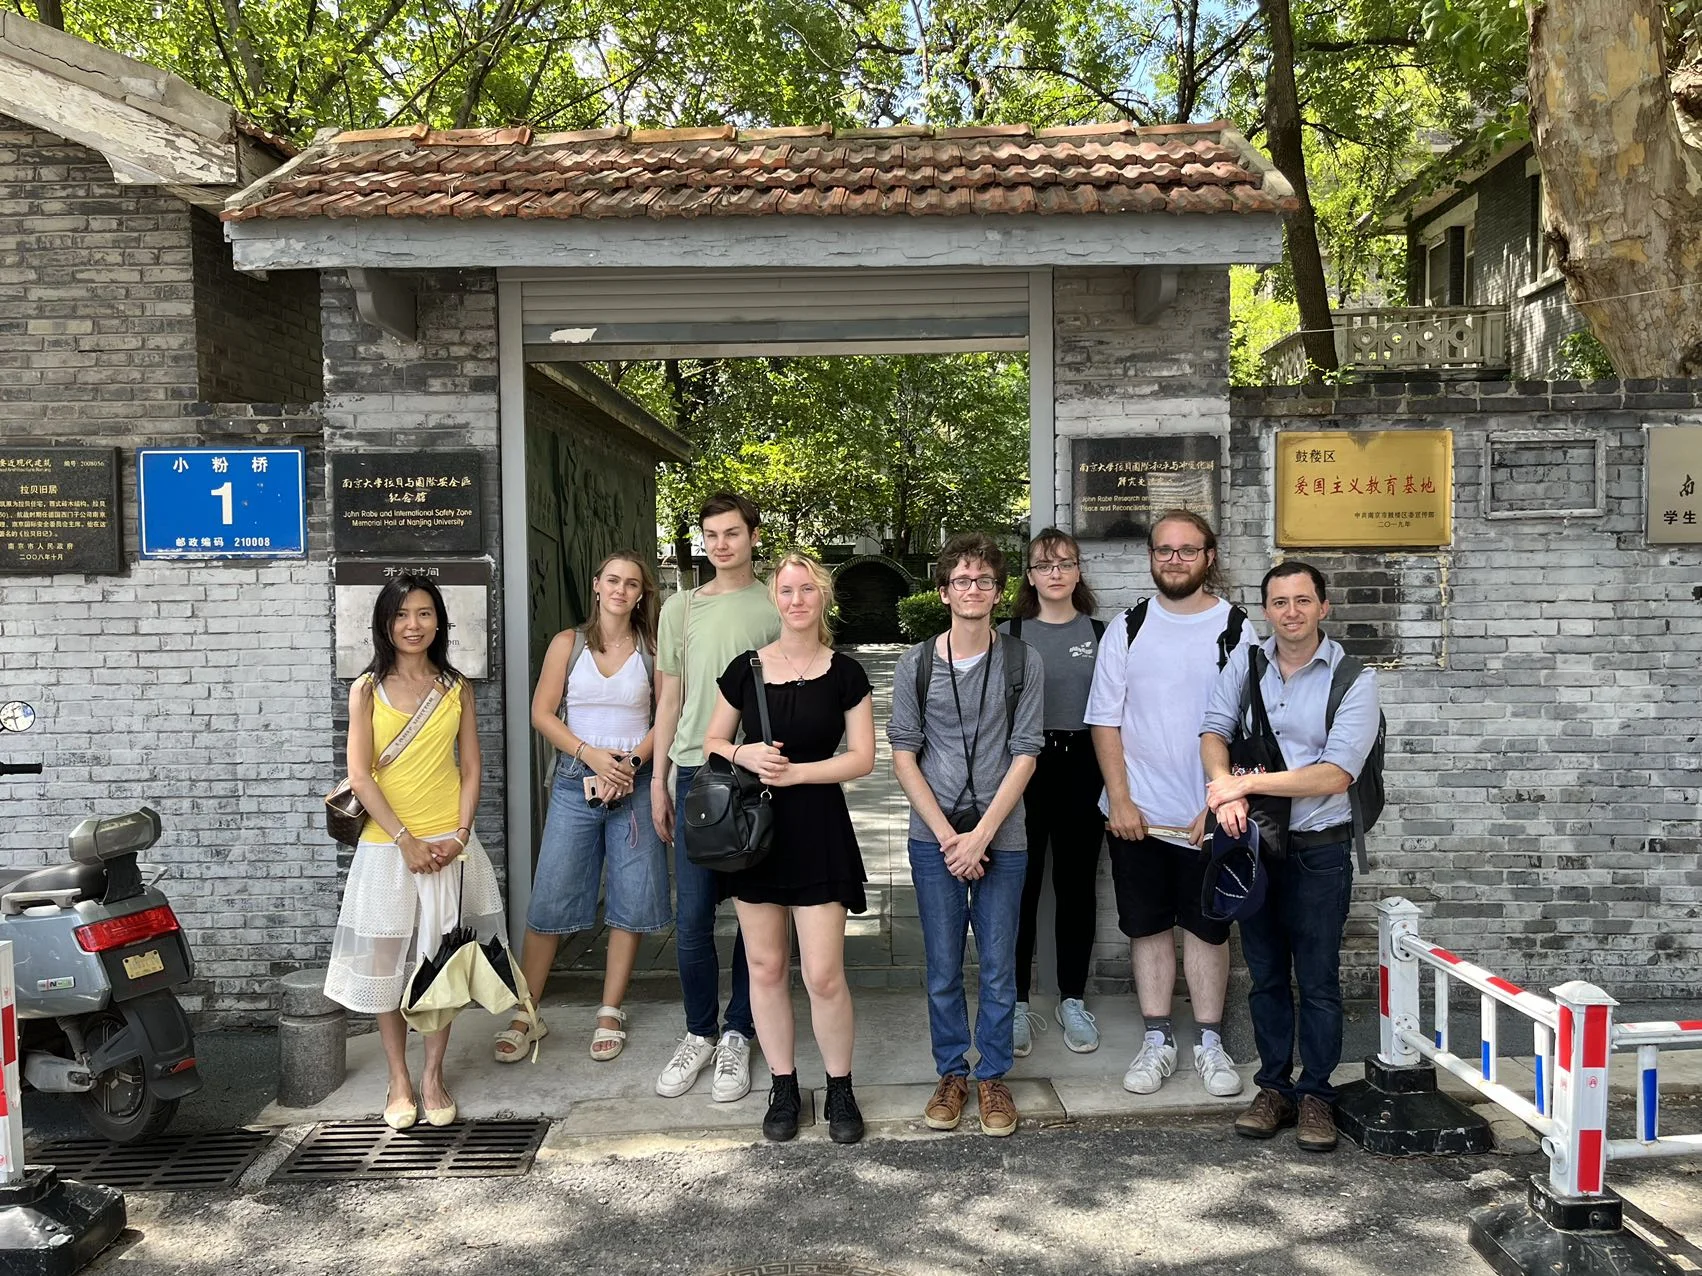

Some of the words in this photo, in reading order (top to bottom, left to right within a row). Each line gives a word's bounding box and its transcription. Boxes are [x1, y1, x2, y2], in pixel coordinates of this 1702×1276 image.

[1295, 450, 1336, 463] 鼓楼区
[64, 460, 76, 468] 编号
[173, 456, 268, 473] 小粉桥
[20, 485, 58, 495] 拉贝旧居
[1294, 475, 1436, 496] 爱国主义教育基地
[210, 482, 233, 525] 1
[394, 509, 434, 517] International
[435, 509, 455, 518] Safety
[1354, 511, 1435, 519] 中共南京市鼓楼区委宣传部
[1663, 510, 1697, 525] 学生
[407, 519, 432, 527] Nanjing
[433, 519, 465, 527] University
[175, 537, 224, 547] 邮政编码
[234, 537, 270, 547] 210008
[383, 566, 439, 577] 开放时间
